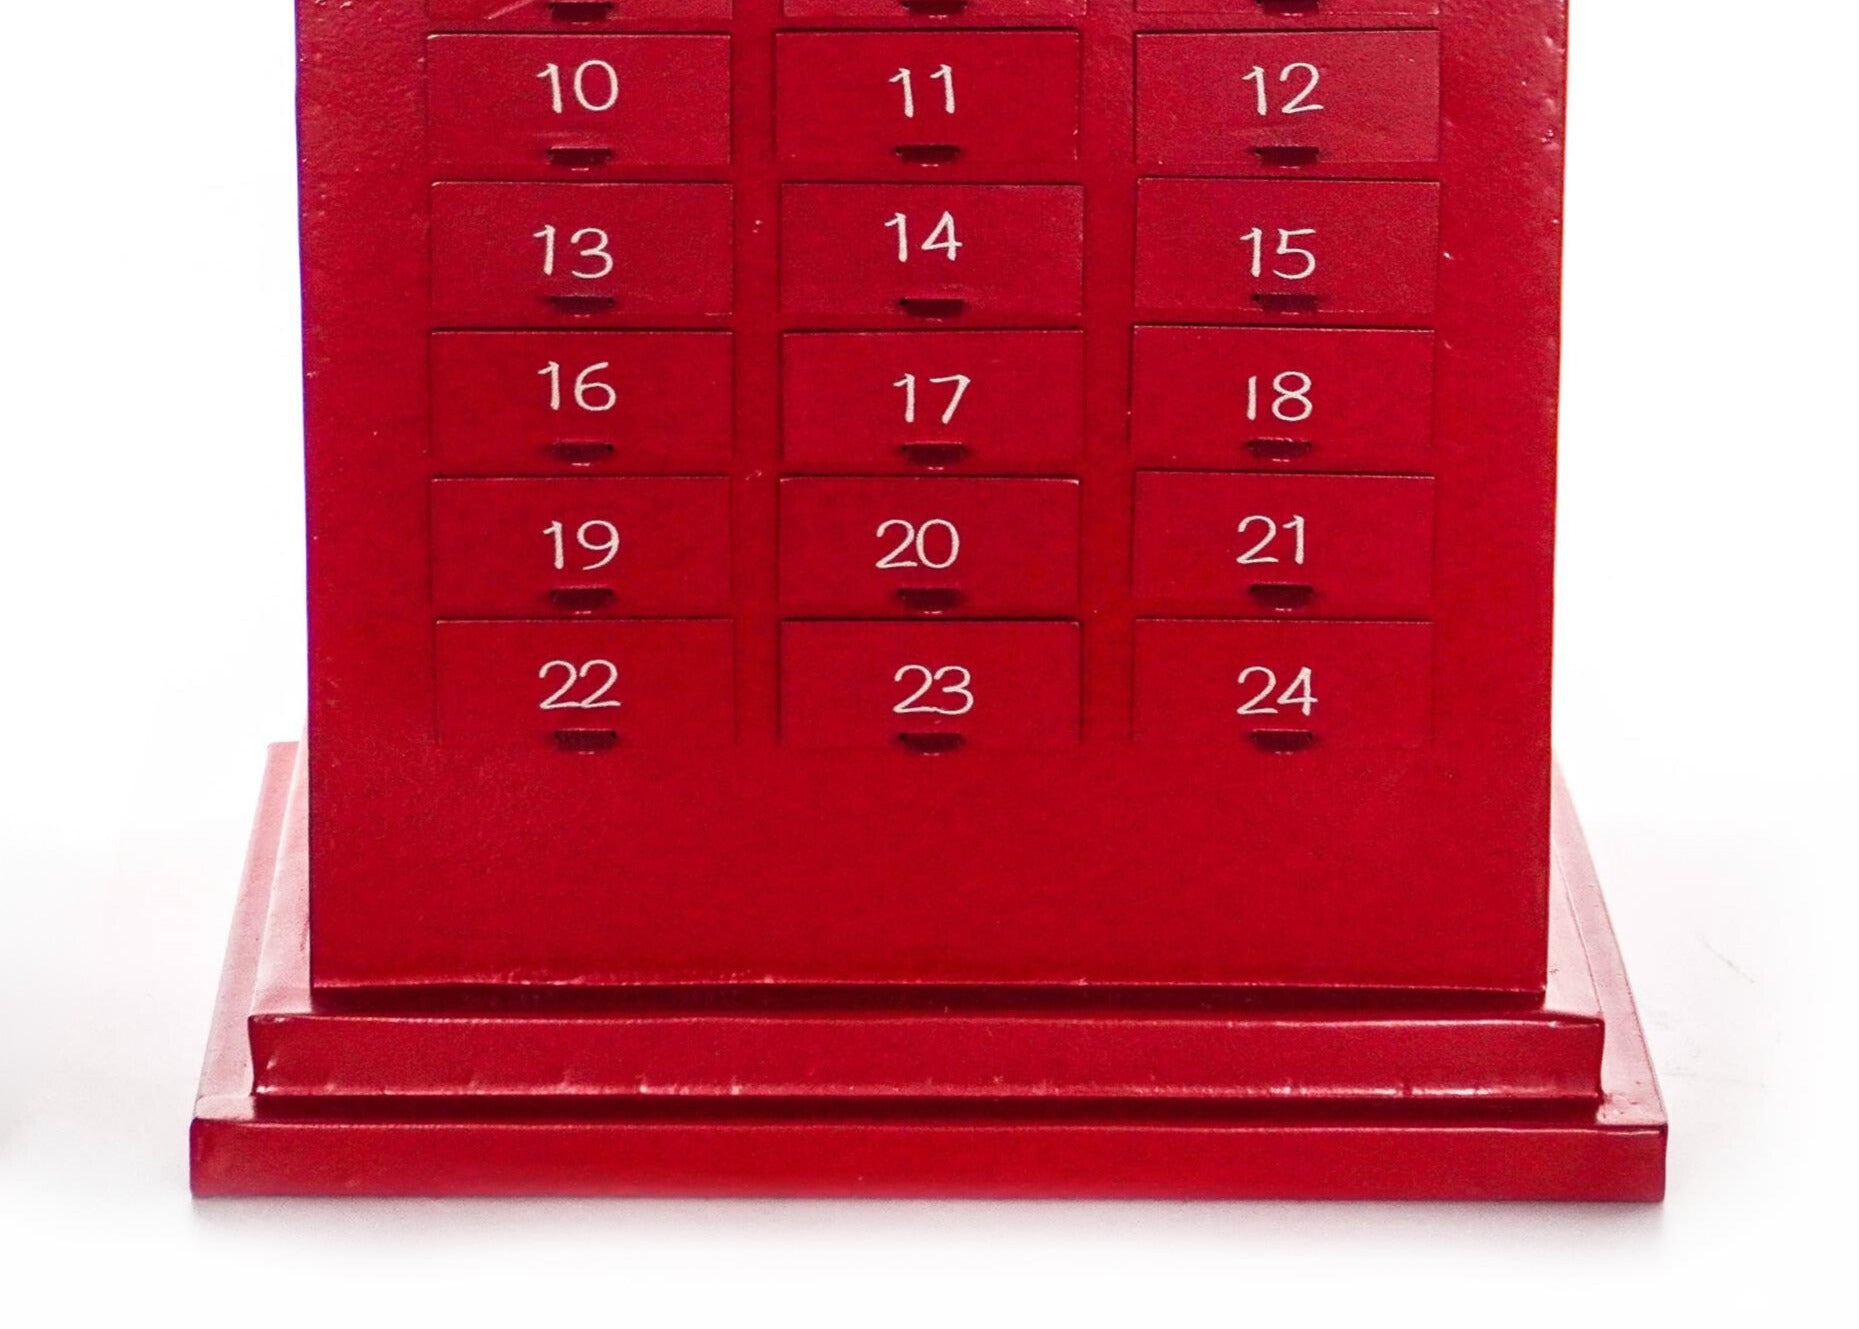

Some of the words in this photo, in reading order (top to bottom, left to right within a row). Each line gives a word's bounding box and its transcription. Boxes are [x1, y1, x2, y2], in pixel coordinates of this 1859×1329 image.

[536, 59, 619, 114] 10
[889, 64, 955, 118] 11
[1242, 62, 1324, 116] 12
[533, 224, 614, 279] 13
[884, 210, 963, 263] 14
[1240, 227, 1316, 280] 15
[538, 361, 617, 411] 16
[893, 373, 971, 424] 17
[1247, 371, 1313, 422] 18
[543, 519, 620, 570] 19
[875, 518, 960, 569] 20
[1236, 515, 1305, 565] 21
[539, 659, 621, 710] 22
[893, 664, 974, 715] 23
[1236, 666, 1318, 716] 24
